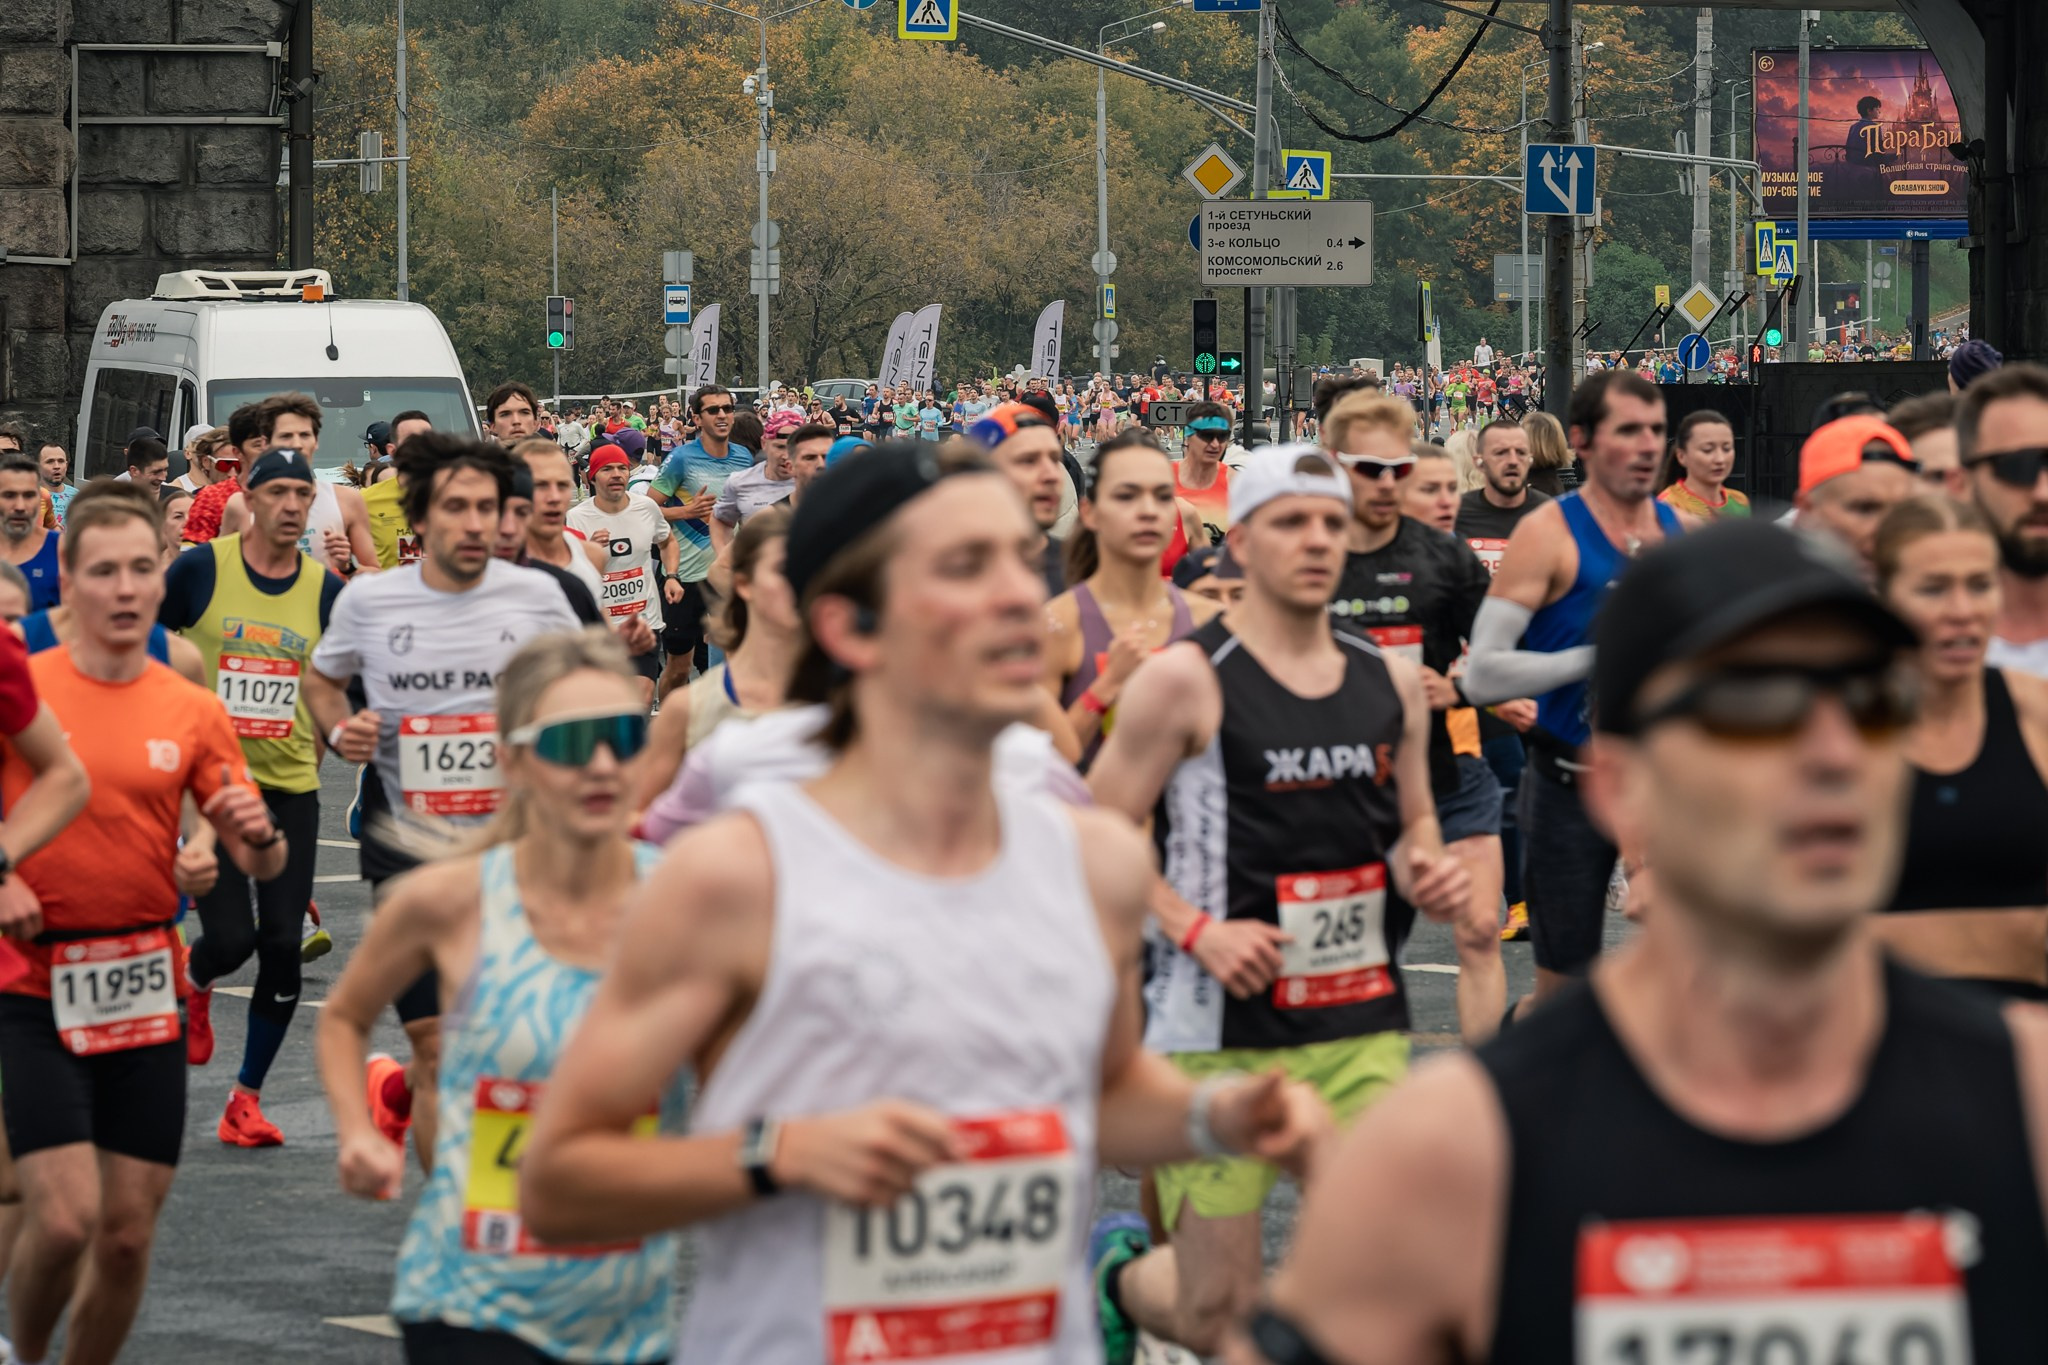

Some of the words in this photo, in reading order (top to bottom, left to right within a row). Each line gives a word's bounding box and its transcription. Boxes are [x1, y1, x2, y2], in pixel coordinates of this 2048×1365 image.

[1761, 58, 1772, 70] 6+
[1880, 161, 1924, 174] Волшебная
[1925, 162, 1951, 173] страна
[1893, 184, 1946, 192] PARABAYKI.SHOW
[1208, 210, 1226, 220] 1-й
[1229, 209, 1312, 220] СЕТУНЬСКИЙ
[1208, 222, 1250, 231] проезд
[1208, 238, 1225, 248] 3-е
[1229, 238, 1281, 249] КОЛЬЦО
[1326, 239, 1343, 248] 0.4
[1208, 254, 1322, 266] КОМСОМОЛЬСКИЙ
[1326, 261, 1343, 271] 2.6
[1208, 268, 1263, 277] проспект
[602, 579, 644, 599] 20809
[388, 671, 455, 691] WOLF
[223, 677, 295, 705] 11072
[416, 740, 497, 771] 1623
[1263, 743, 1377, 783] ЖАРА
[1313, 902, 1366, 950] 265
[61, 955, 166, 1005] 11955
[856, 1173, 1061, 1258] 10348
